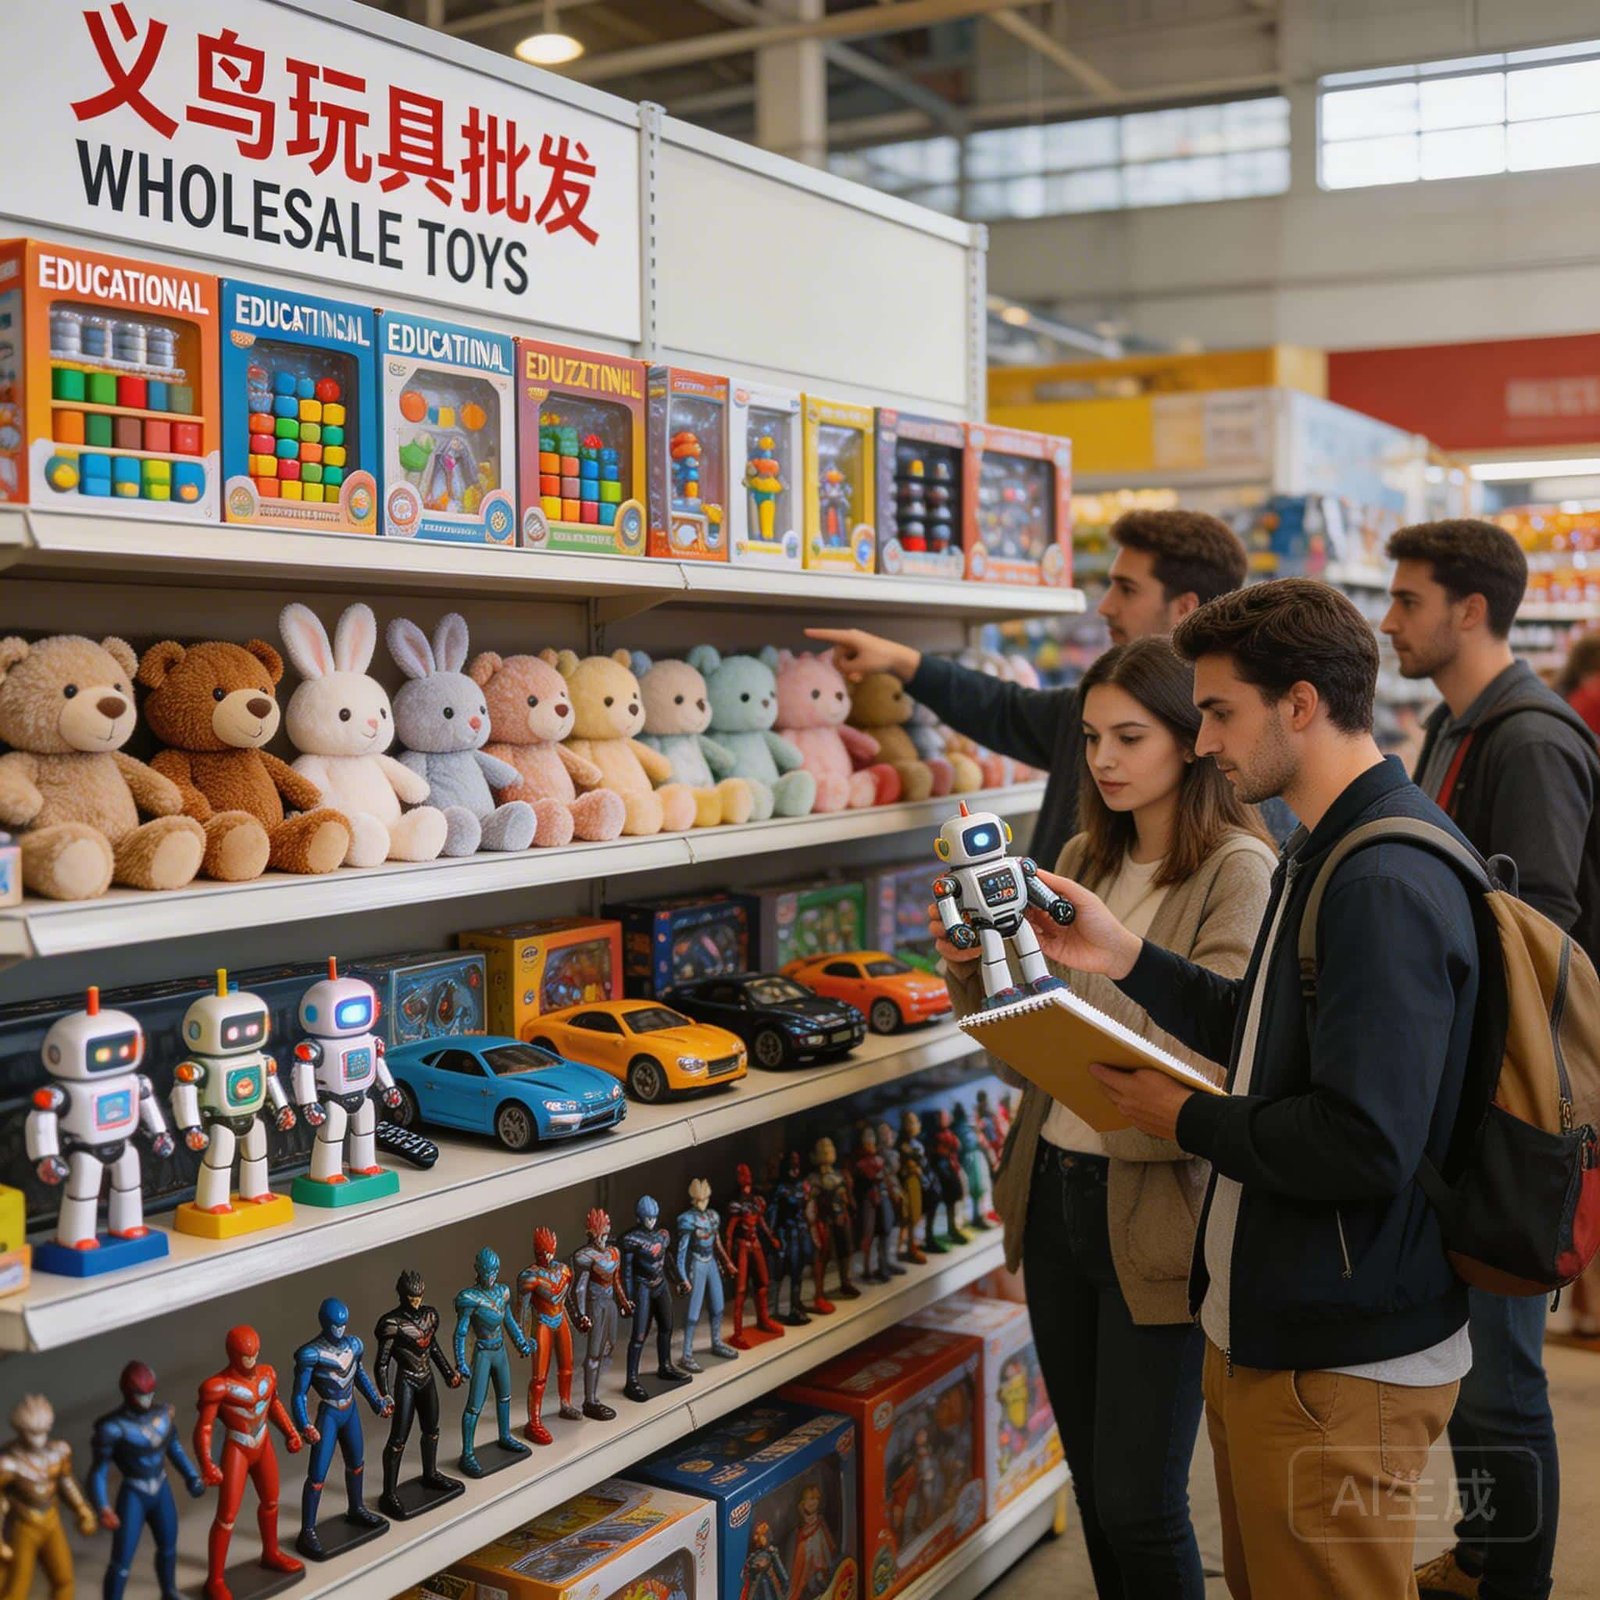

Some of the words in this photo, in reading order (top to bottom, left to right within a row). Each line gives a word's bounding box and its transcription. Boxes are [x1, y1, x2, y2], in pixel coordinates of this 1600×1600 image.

[71, 3, 600, 246] 义乌玩具批发
[38, 253, 210, 316] EDUCATIONAL
[76, 138, 403, 270] WHOLESALE
[418, 218, 530, 296] TOYS
